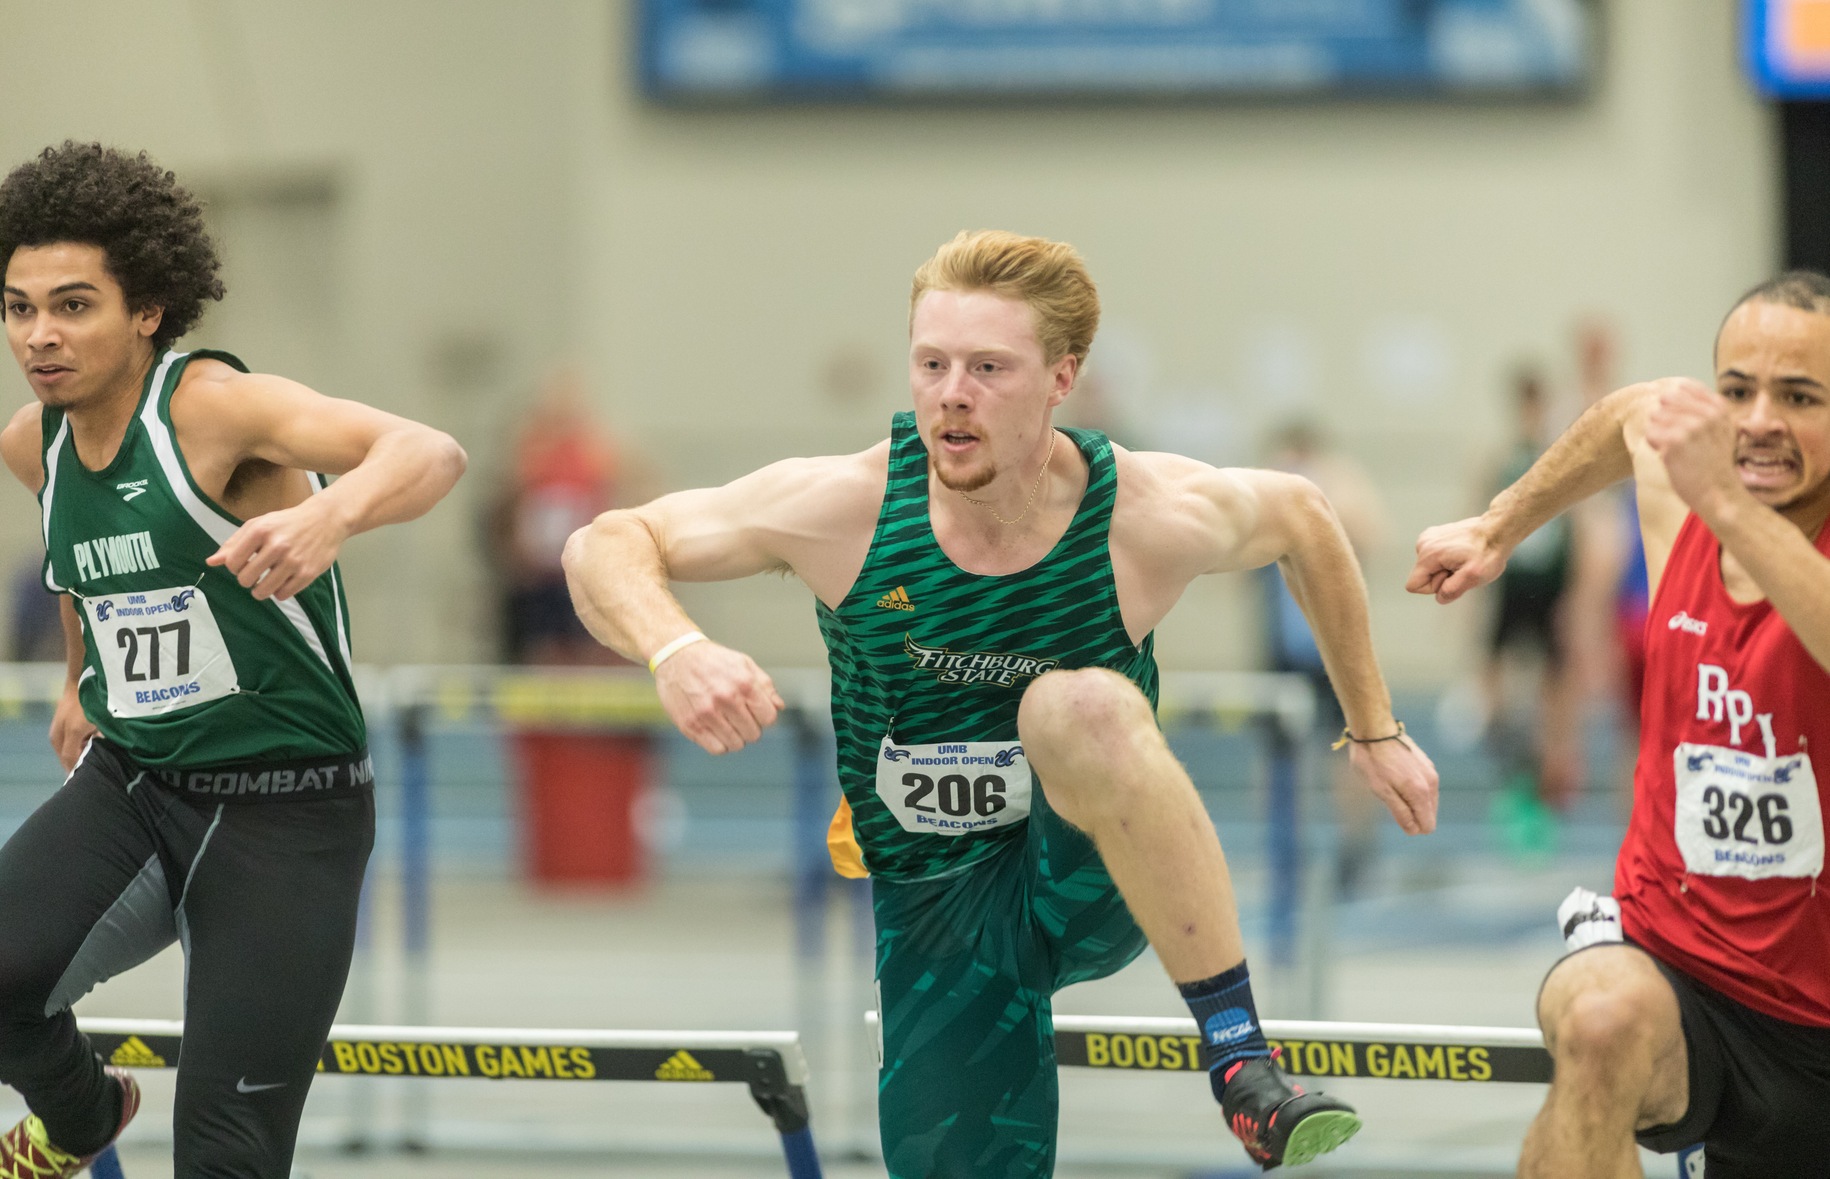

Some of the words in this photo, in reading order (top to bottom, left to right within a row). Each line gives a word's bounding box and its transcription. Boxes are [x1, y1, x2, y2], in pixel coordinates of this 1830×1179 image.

[73, 531, 160, 582] PLYMOUTH
[116, 607, 144, 617] INDOOR
[145, 602, 173, 616] OPEN
[127, 595, 147, 605] UMB
[877, 599, 915, 612] adidas
[116, 619, 191, 682] 277
[908, 646, 1057, 675] FITCHBURG
[941, 669, 1016, 686] STATE
[135, 681, 201, 704] BEACONS
[1696, 663, 1776, 759] RPI
[911, 757, 958, 766] INDOOR
[961, 757, 994, 765] OPEN
[937, 744, 968, 755] UMB
[187, 765, 339, 795] COMBAT
[901, 772, 1007, 818] 206
[916, 814, 998, 829] BEACONS
[1702, 785, 1793, 845] 326
[333, 1040, 471, 1076] BOSTON
[475, 1044, 597, 1080] GAMES
[1085, 1033, 1202, 1071] BOOST
[1366, 1043, 1493, 1081] GAMES
